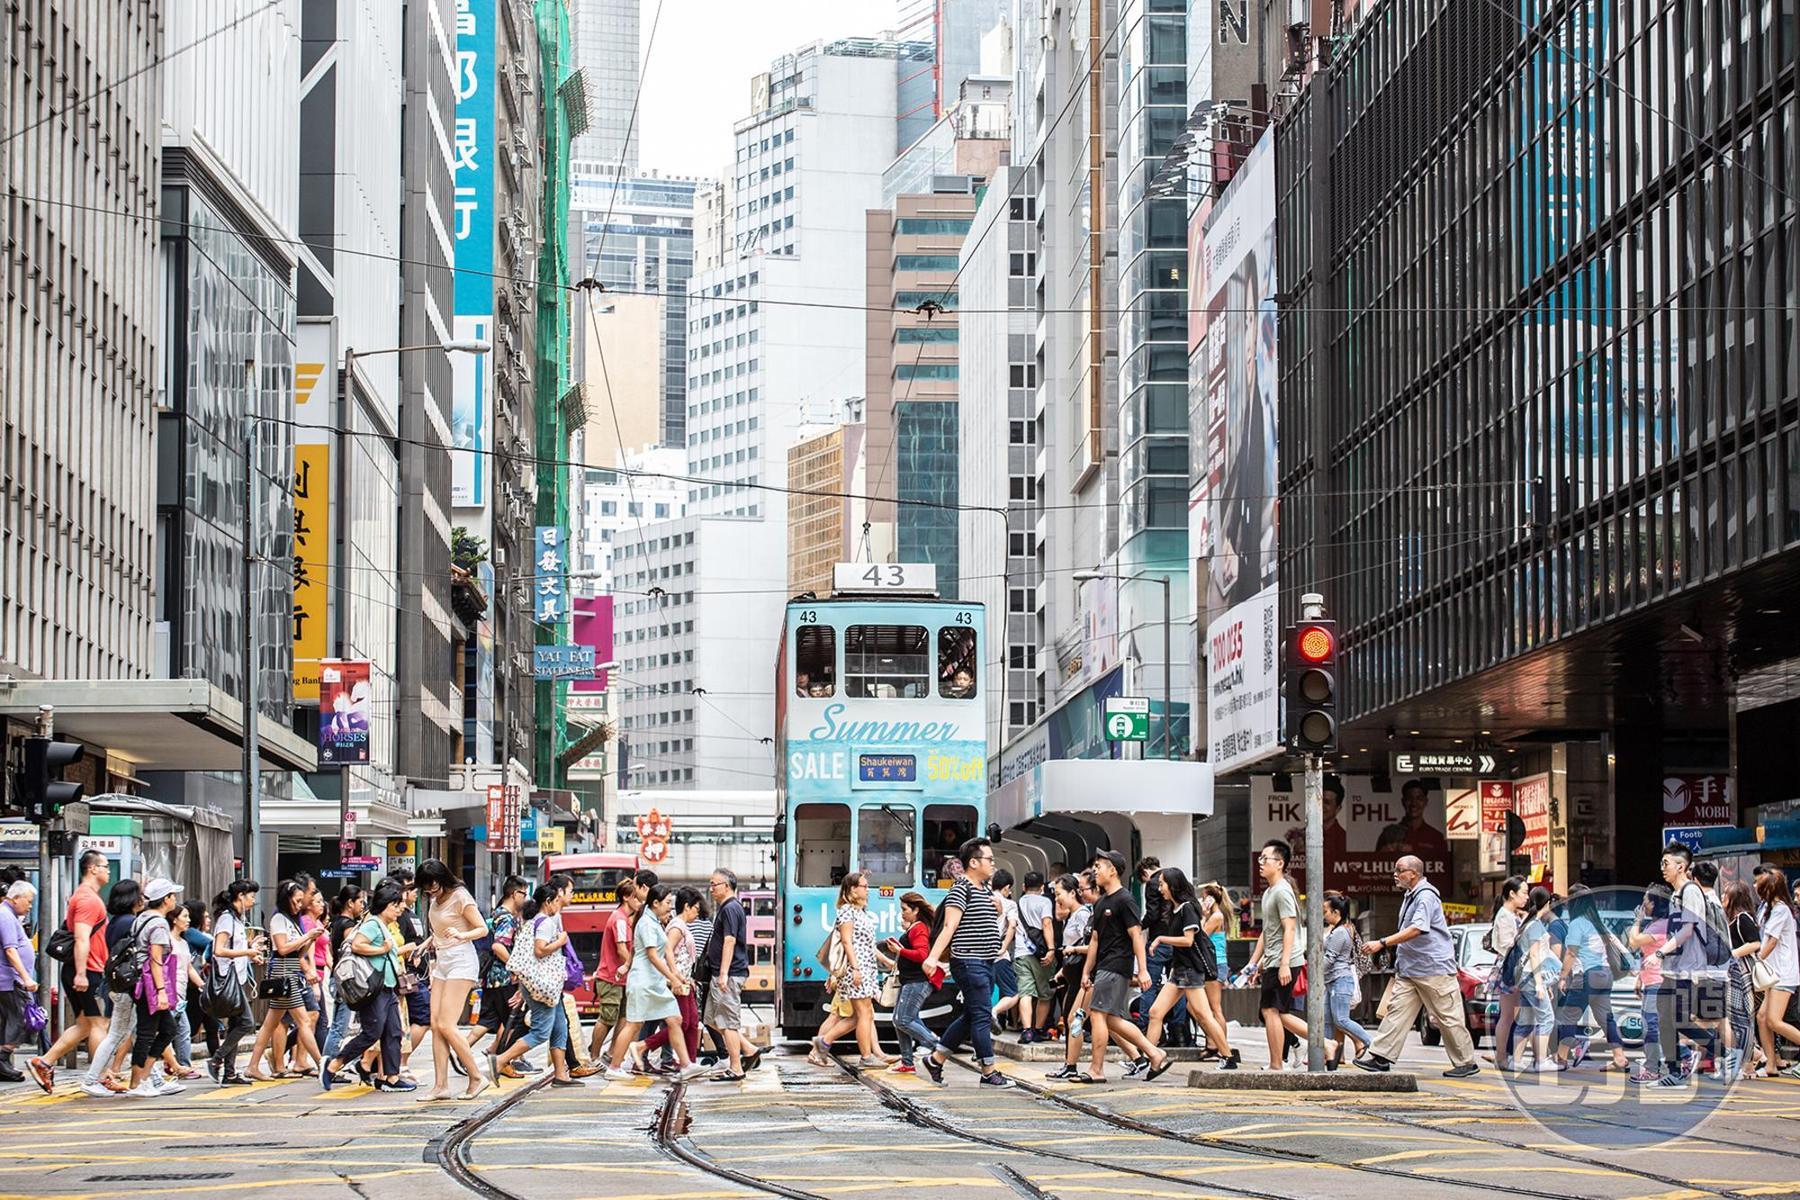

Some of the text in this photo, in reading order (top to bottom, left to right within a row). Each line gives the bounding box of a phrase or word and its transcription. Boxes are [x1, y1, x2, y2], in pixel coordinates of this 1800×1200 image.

[537, 528, 562, 621] 日發文具
[862, 565, 905, 587] 43
[800, 611, 817, 623] 43
[955, 612, 972, 625] 43
[538, 651, 592, 662] YAT FAT
[809, 703, 960, 742] Summer
[325, 733, 366, 742] HORSES
[791, 752, 844, 780] SALE
[861, 757, 914, 767] Shaukeiwan
[1268, 804, 1302, 822] HK
[1352, 804, 1398, 822] PHL
